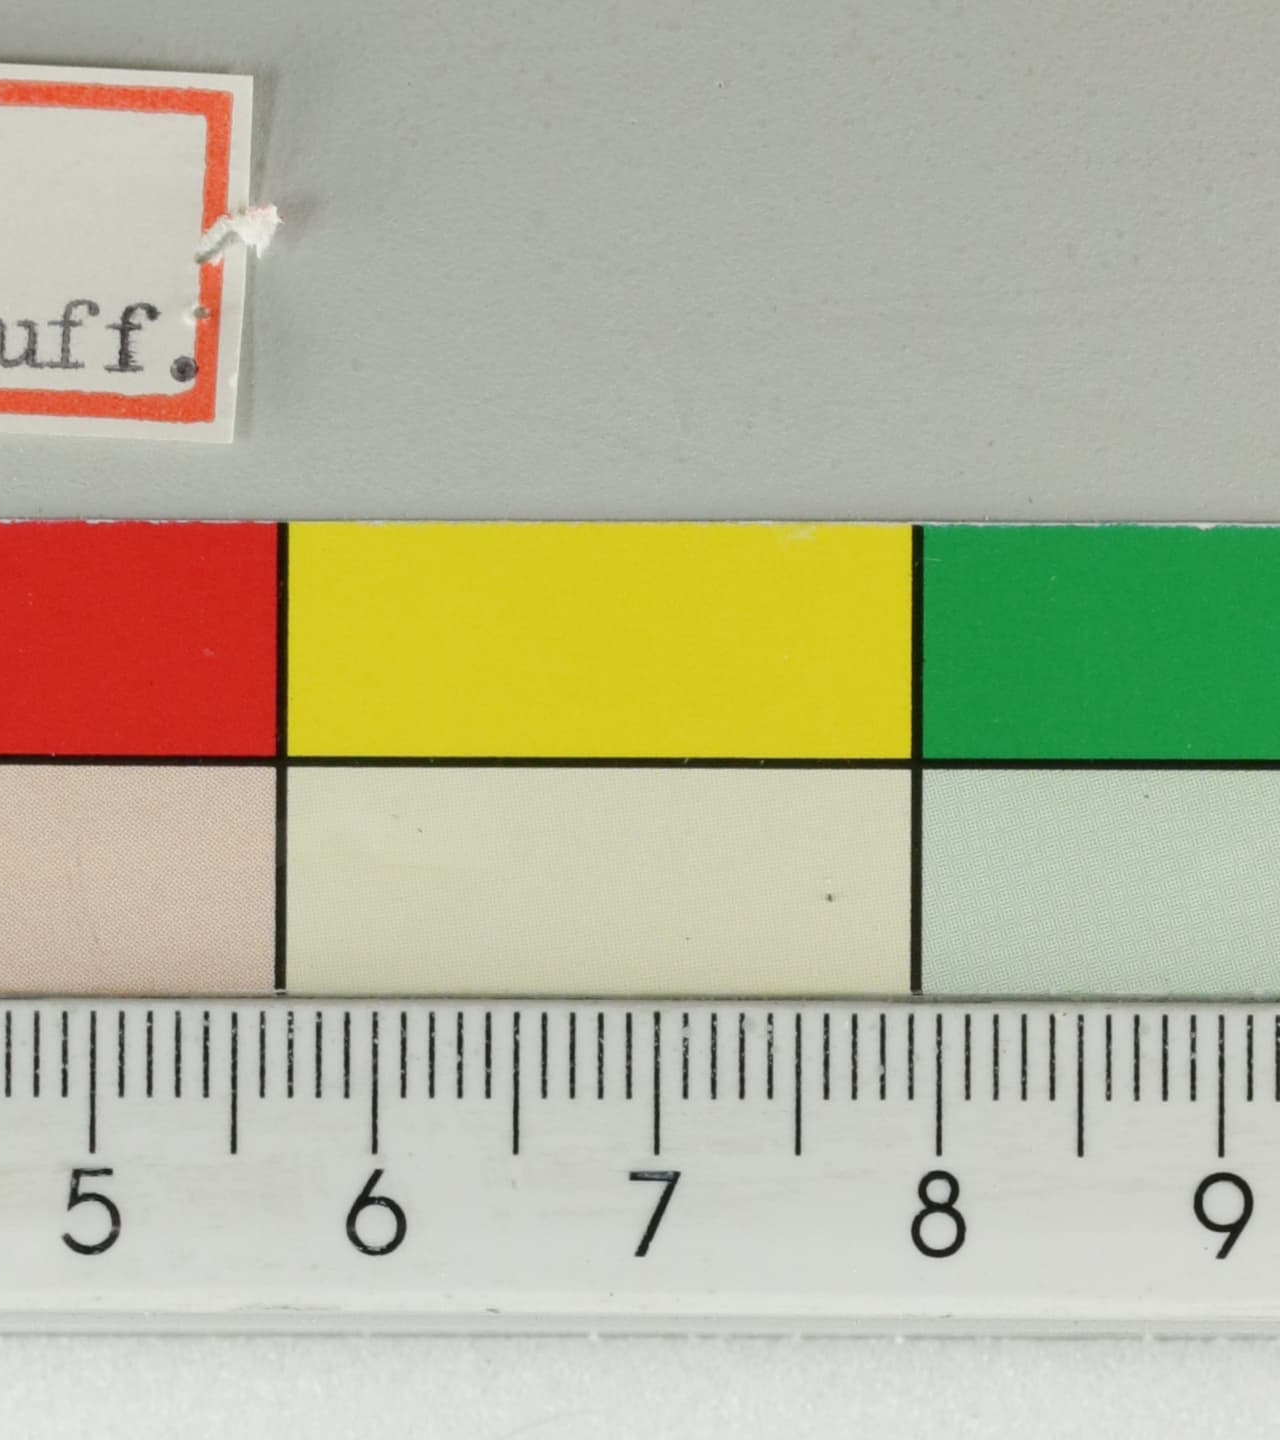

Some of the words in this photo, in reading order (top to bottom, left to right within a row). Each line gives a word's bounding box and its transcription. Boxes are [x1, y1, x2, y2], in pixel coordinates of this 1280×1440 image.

[60, 1166, 123, 1257] 5
[344, 1167, 409, 1258] 6
[627, 1169, 683, 1259] 7
[909, 1168, 968, 1260] 8
[1191, 1170, 1256, 1261] 9
